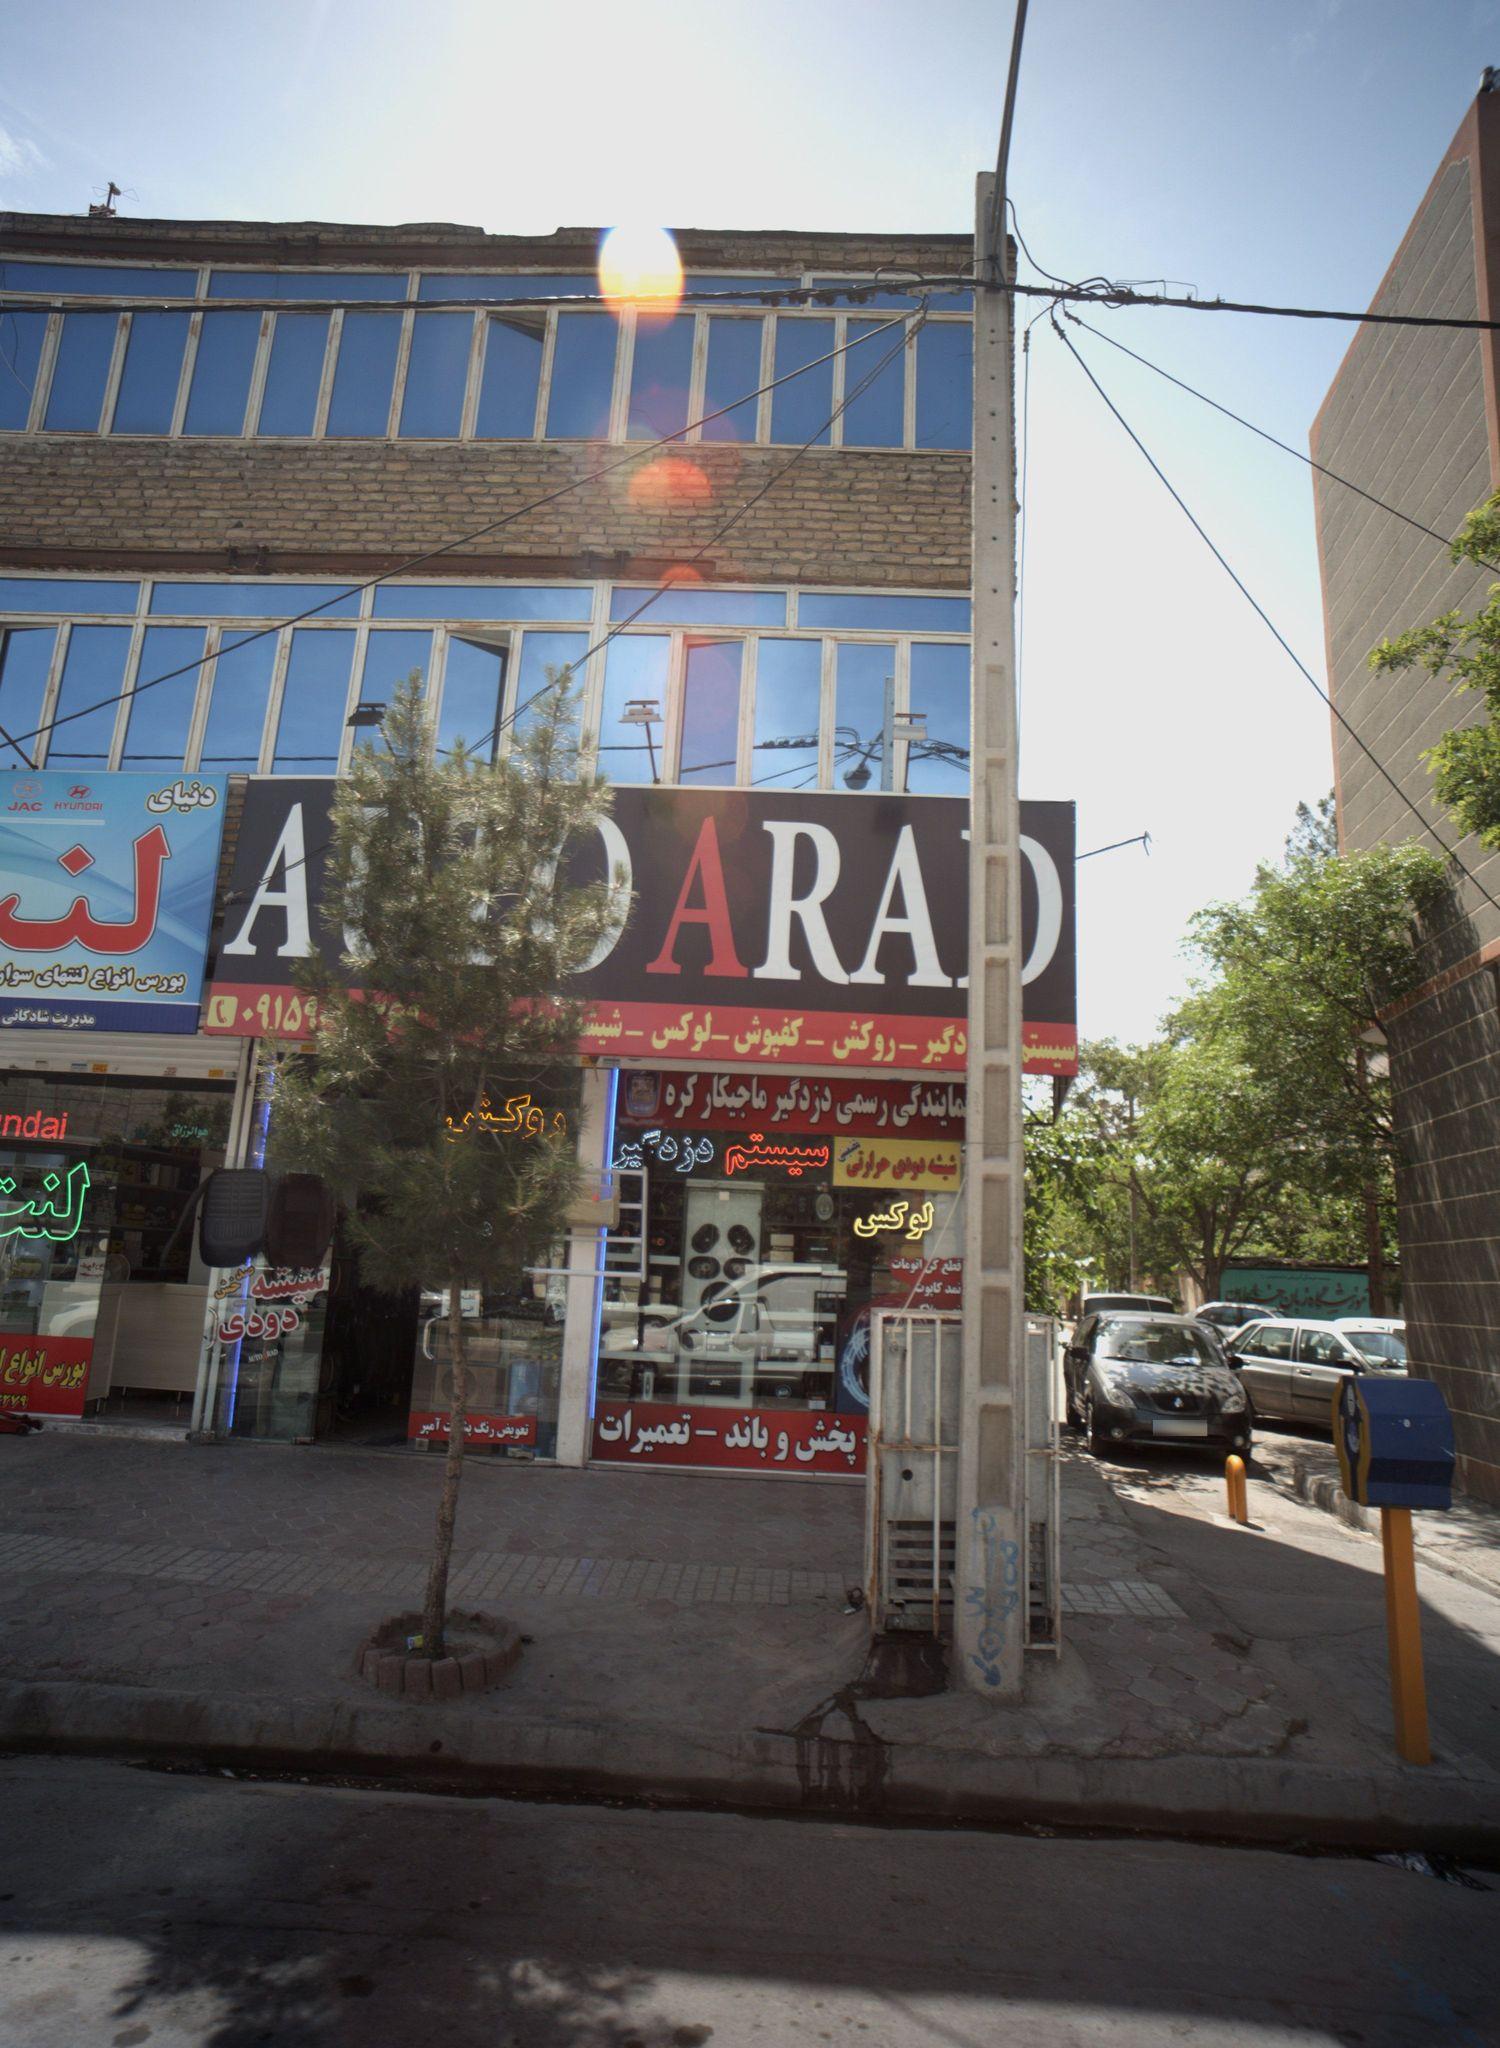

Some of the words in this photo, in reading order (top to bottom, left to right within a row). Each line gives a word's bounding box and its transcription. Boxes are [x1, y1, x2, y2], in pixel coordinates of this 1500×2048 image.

[7, 802, 43, 812] JAC
[54, 802, 103, 811] HYUNDAI
[147, 780, 217, 814] دنیای
[0, 823, 172, 954] لن
[35, 963, 89, 988] لنتهای
[88, 966, 135, 991] انواع
[135, 974, 187, 993] بورس
[52, 1013, 95, 1028] مدیریت
[577, 1009, 623, 1046] شیش
[652, 1010, 713, 1051] لوکس
[733, 1015, 804, 1058] کفپوش
[832, 1020, 896, 1062] روکش
[921, 1025, 967, 1063] دگیر
[665, 1073, 698, 1119] کره
[701, 1074, 767, 1120] ماجیکار
[771, 1077, 832, 1124] دزدگیر
[836, 1093, 888, 1127] رسمی
[892, 1083, 967, 1127] مایندگی
[0, 1110, 69, 1140] ndai
[611, 1128, 715, 1173] دزدگیر
[725, 1132, 831, 1176] سیستم
[892, 1156, 926, 1181] دودی
[928, 1153, 958, 1181] شیشه
[853, 1200, 935, 1240] لوکس
[250, 1266, 325, 1305] شیشه
[217, 1307, 300, 1344] دودی
[4, 1348, 47, 1385] انواع
[43, 1360, 87, 1388] بورس
[599, 1408, 692, 1453] تعمیرات
[724, 1414, 770, 1458] باند
[774, 1430, 789, 1461] و
[794, 1418, 857, 1465] پخش
